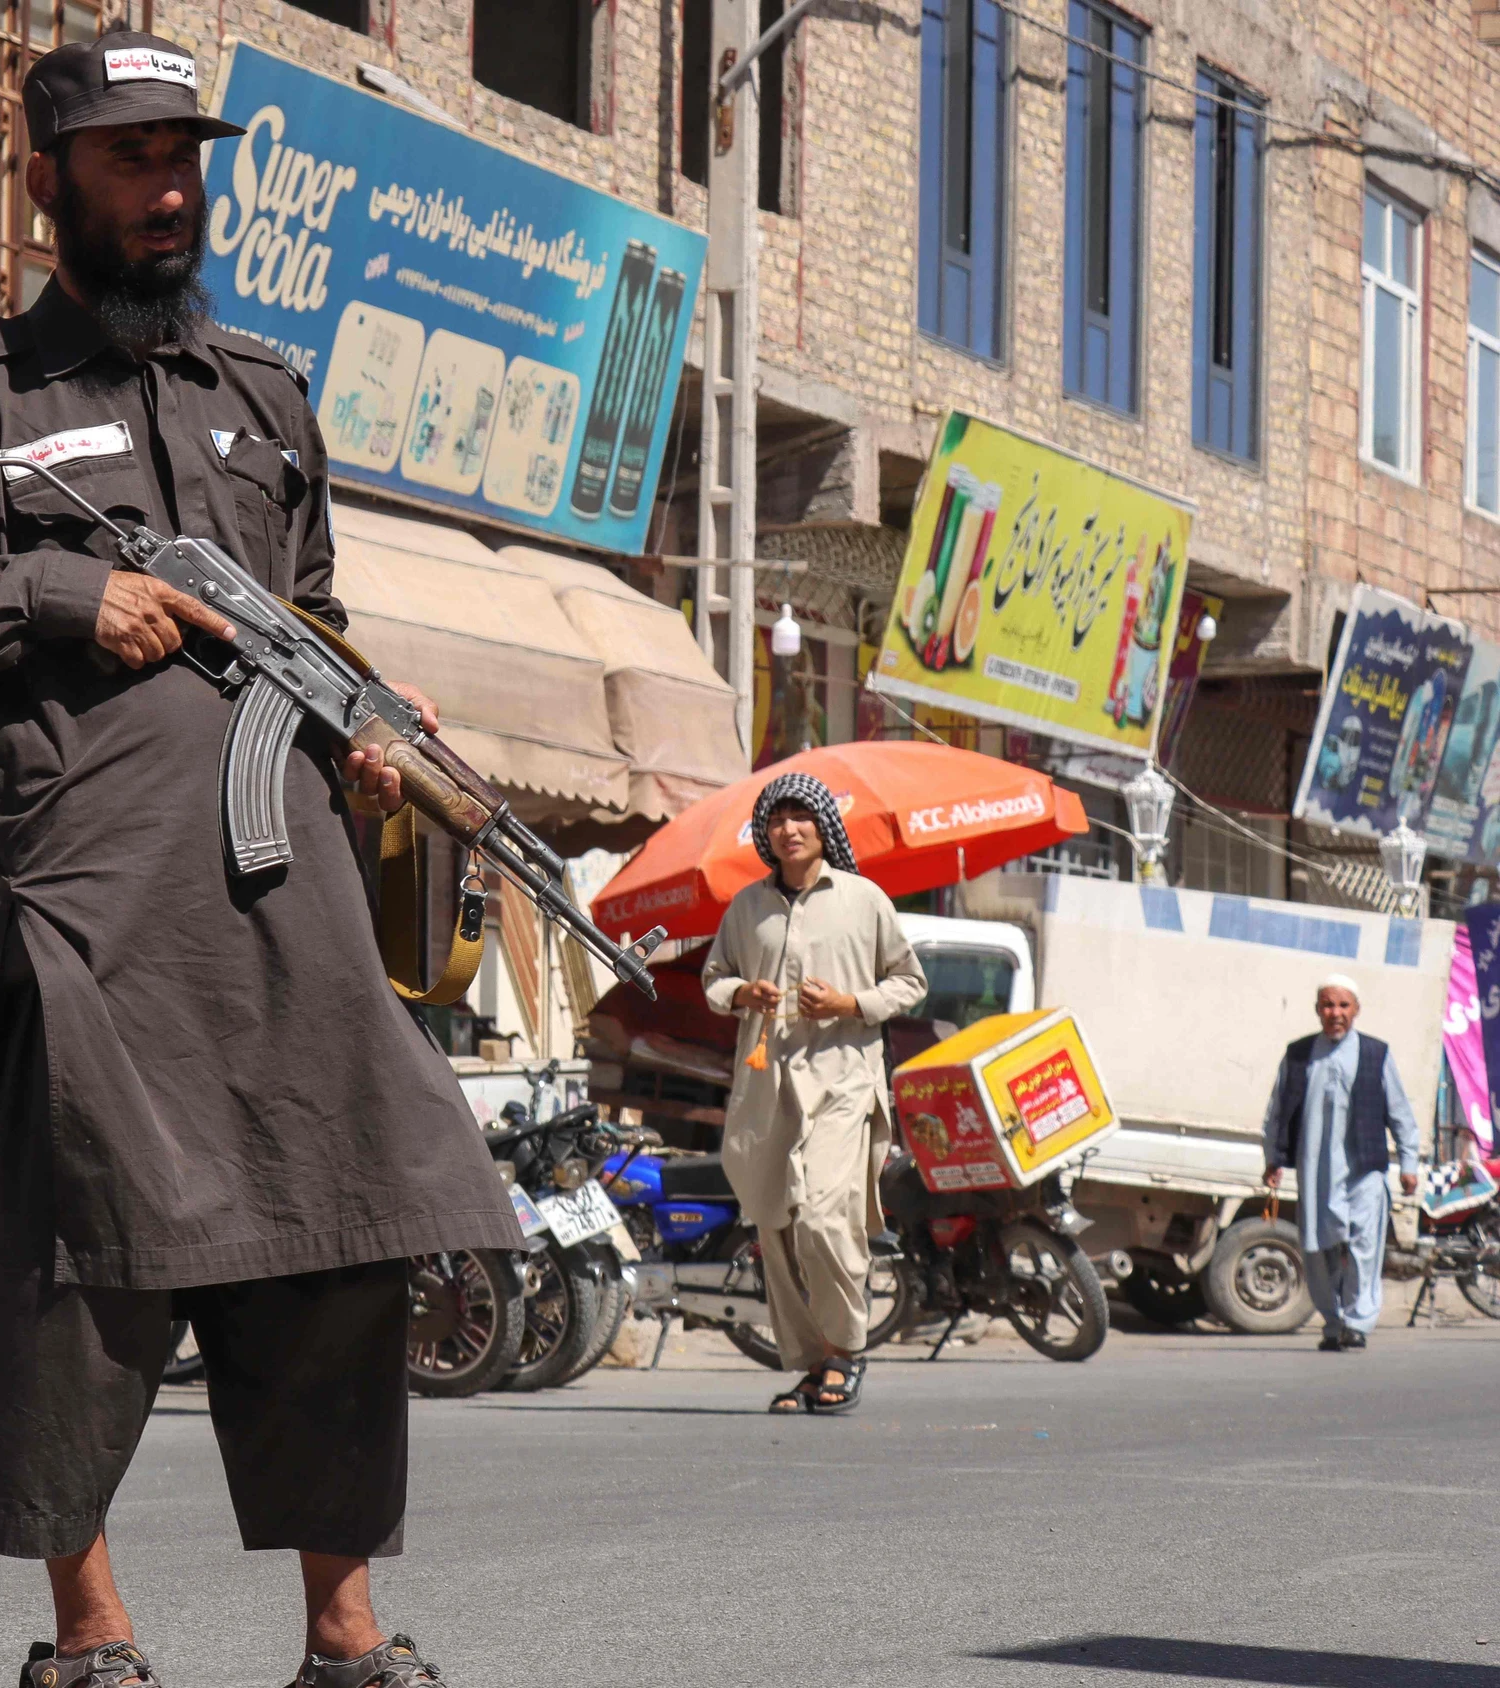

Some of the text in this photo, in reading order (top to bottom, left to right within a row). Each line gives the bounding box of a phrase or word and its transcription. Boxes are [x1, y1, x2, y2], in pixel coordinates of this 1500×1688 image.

[108, 53, 151, 72] شهادت
[208, 104, 358, 258] Super
[367, 182, 609, 301] فروشگاه مواد غذایی برادران رحیمی
[907, 791, 1046, 835] ACC Alokozay
